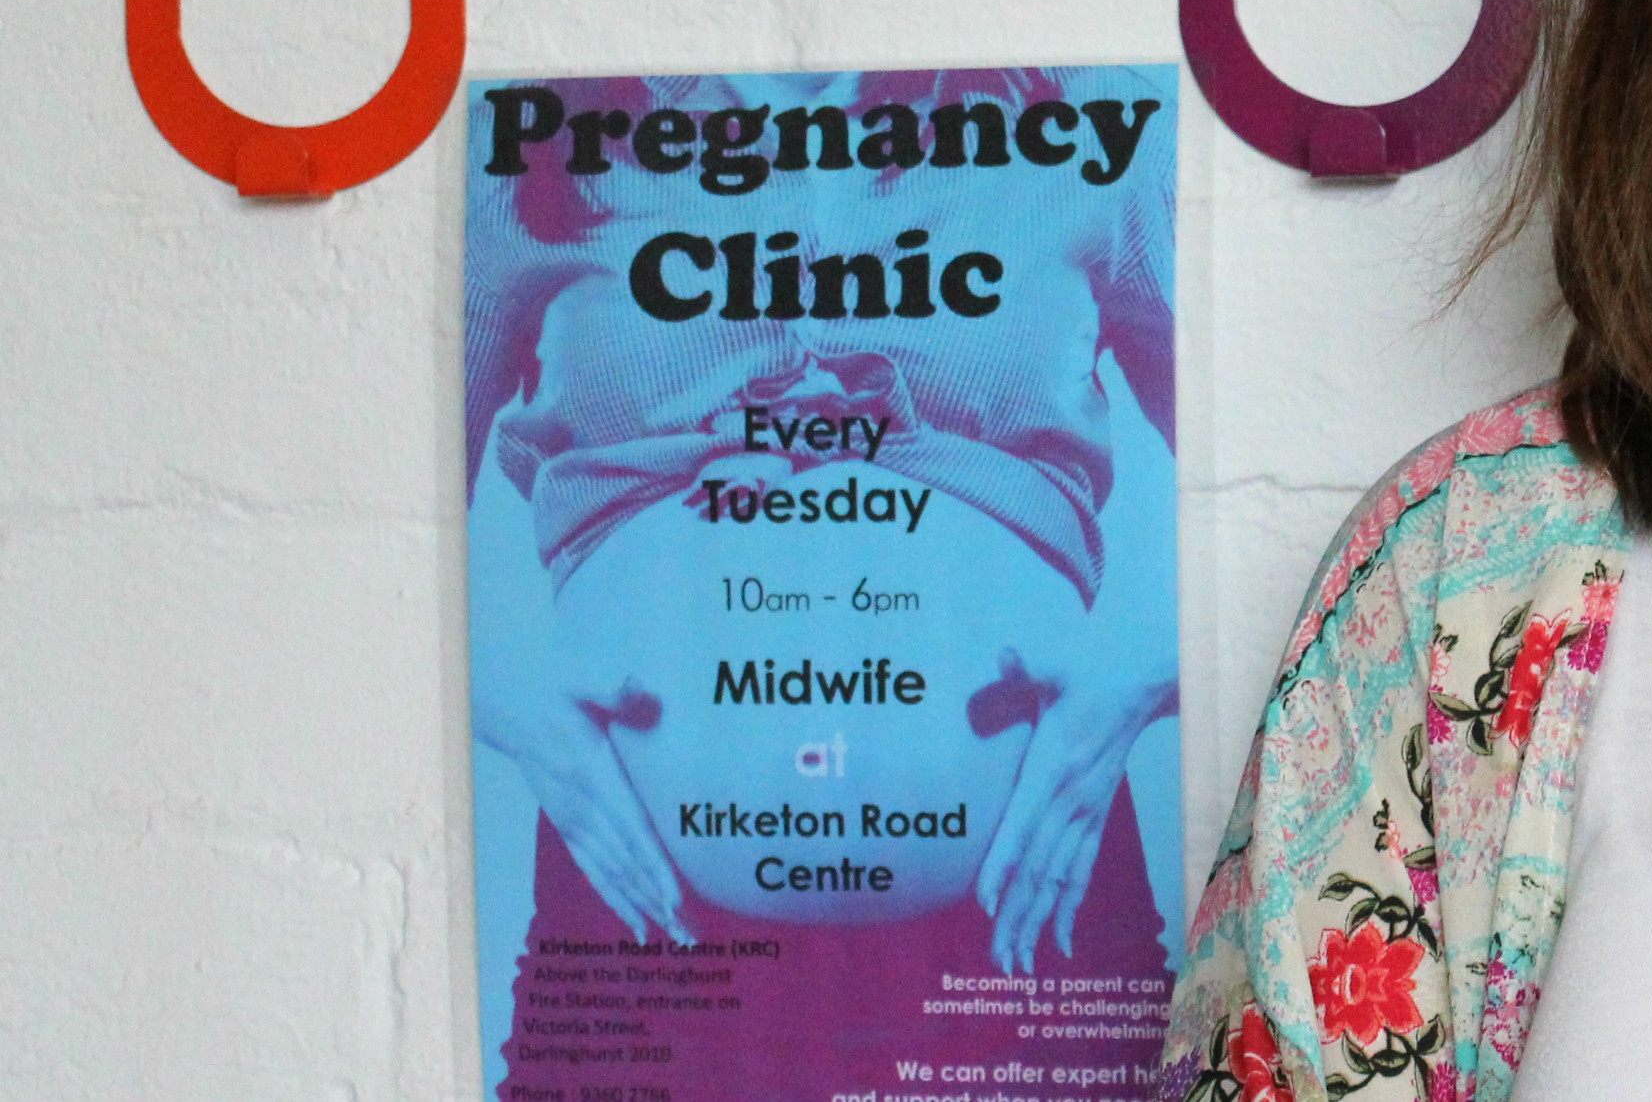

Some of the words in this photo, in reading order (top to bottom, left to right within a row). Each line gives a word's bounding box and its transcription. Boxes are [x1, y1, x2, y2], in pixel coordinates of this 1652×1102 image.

[484, 86, 1161, 195] Pregnancy
[628, 228, 1004, 322] Clinic
[743, 406, 891, 461] Every
[702, 477, 931, 533] Tuesday
[721, 577, 810, 612] 10am
[851, 576, 920, 614] 6pm
[713, 657, 926, 705] Midwife
[795, 732, 848, 778] at
[679, 803, 844, 838] Kirketon
[862, 802, 967, 838] Road
[754, 857, 894, 892] Centre
[540, 940, 613, 956] Kirketon
[618, 940, 663, 956] Road
[667, 941, 726, 957] Centre
[731, 940, 781, 960] (KRC)
[533, 967, 587, 983] Above
[593, 967, 621, 983] the
[942, 974, 1037, 995] Becoming
[1043, 978, 1056, 992] a
[1060, 977, 1122, 995] parent
[1127, 979, 1166, 993] can
[528, 993, 560, 1008] Fire
[636, 995, 713, 1010] entrance
[718, 998, 742, 1010] on
[923, 998, 1024, 1015] sometimes
[1029, 999, 1054, 1016] be
[522, 1018, 590, 1034] Victoria
[1018, 1024, 1036, 1038] or
[630, 1046, 672, 1062] 2010
[896, 1062, 934, 1082] We
[941, 1065, 985, 1082] can
[993, 1062, 1045, 1084] offer
[1052, 1065, 1127, 1088] expert
